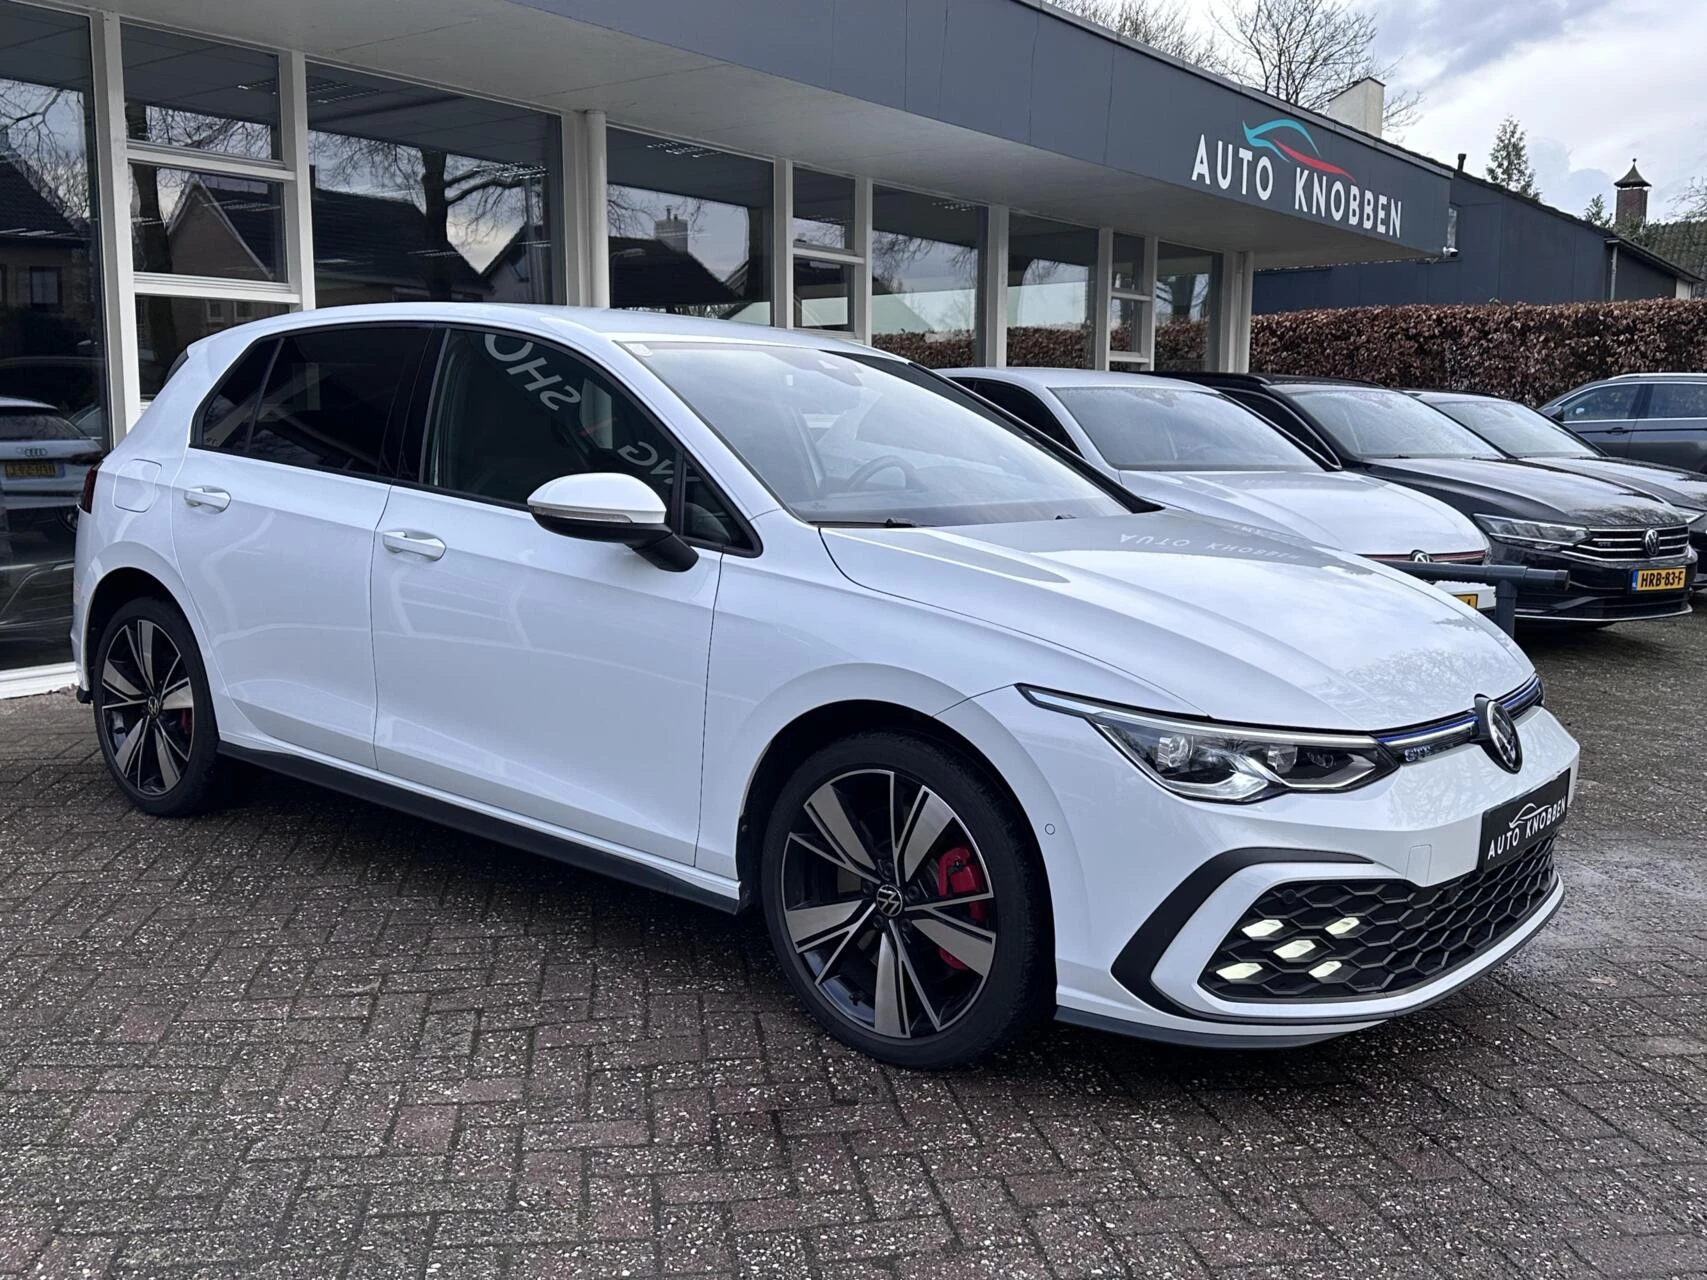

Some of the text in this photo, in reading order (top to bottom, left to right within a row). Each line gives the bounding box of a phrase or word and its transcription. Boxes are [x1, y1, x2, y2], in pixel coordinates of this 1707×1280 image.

[1191, 134, 1402, 239] AUTO KNOBBEN
[1640, 570, 1684, 588] HRB-83-F
[1487, 795, 1567, 860] AUTO KNOBBEN
